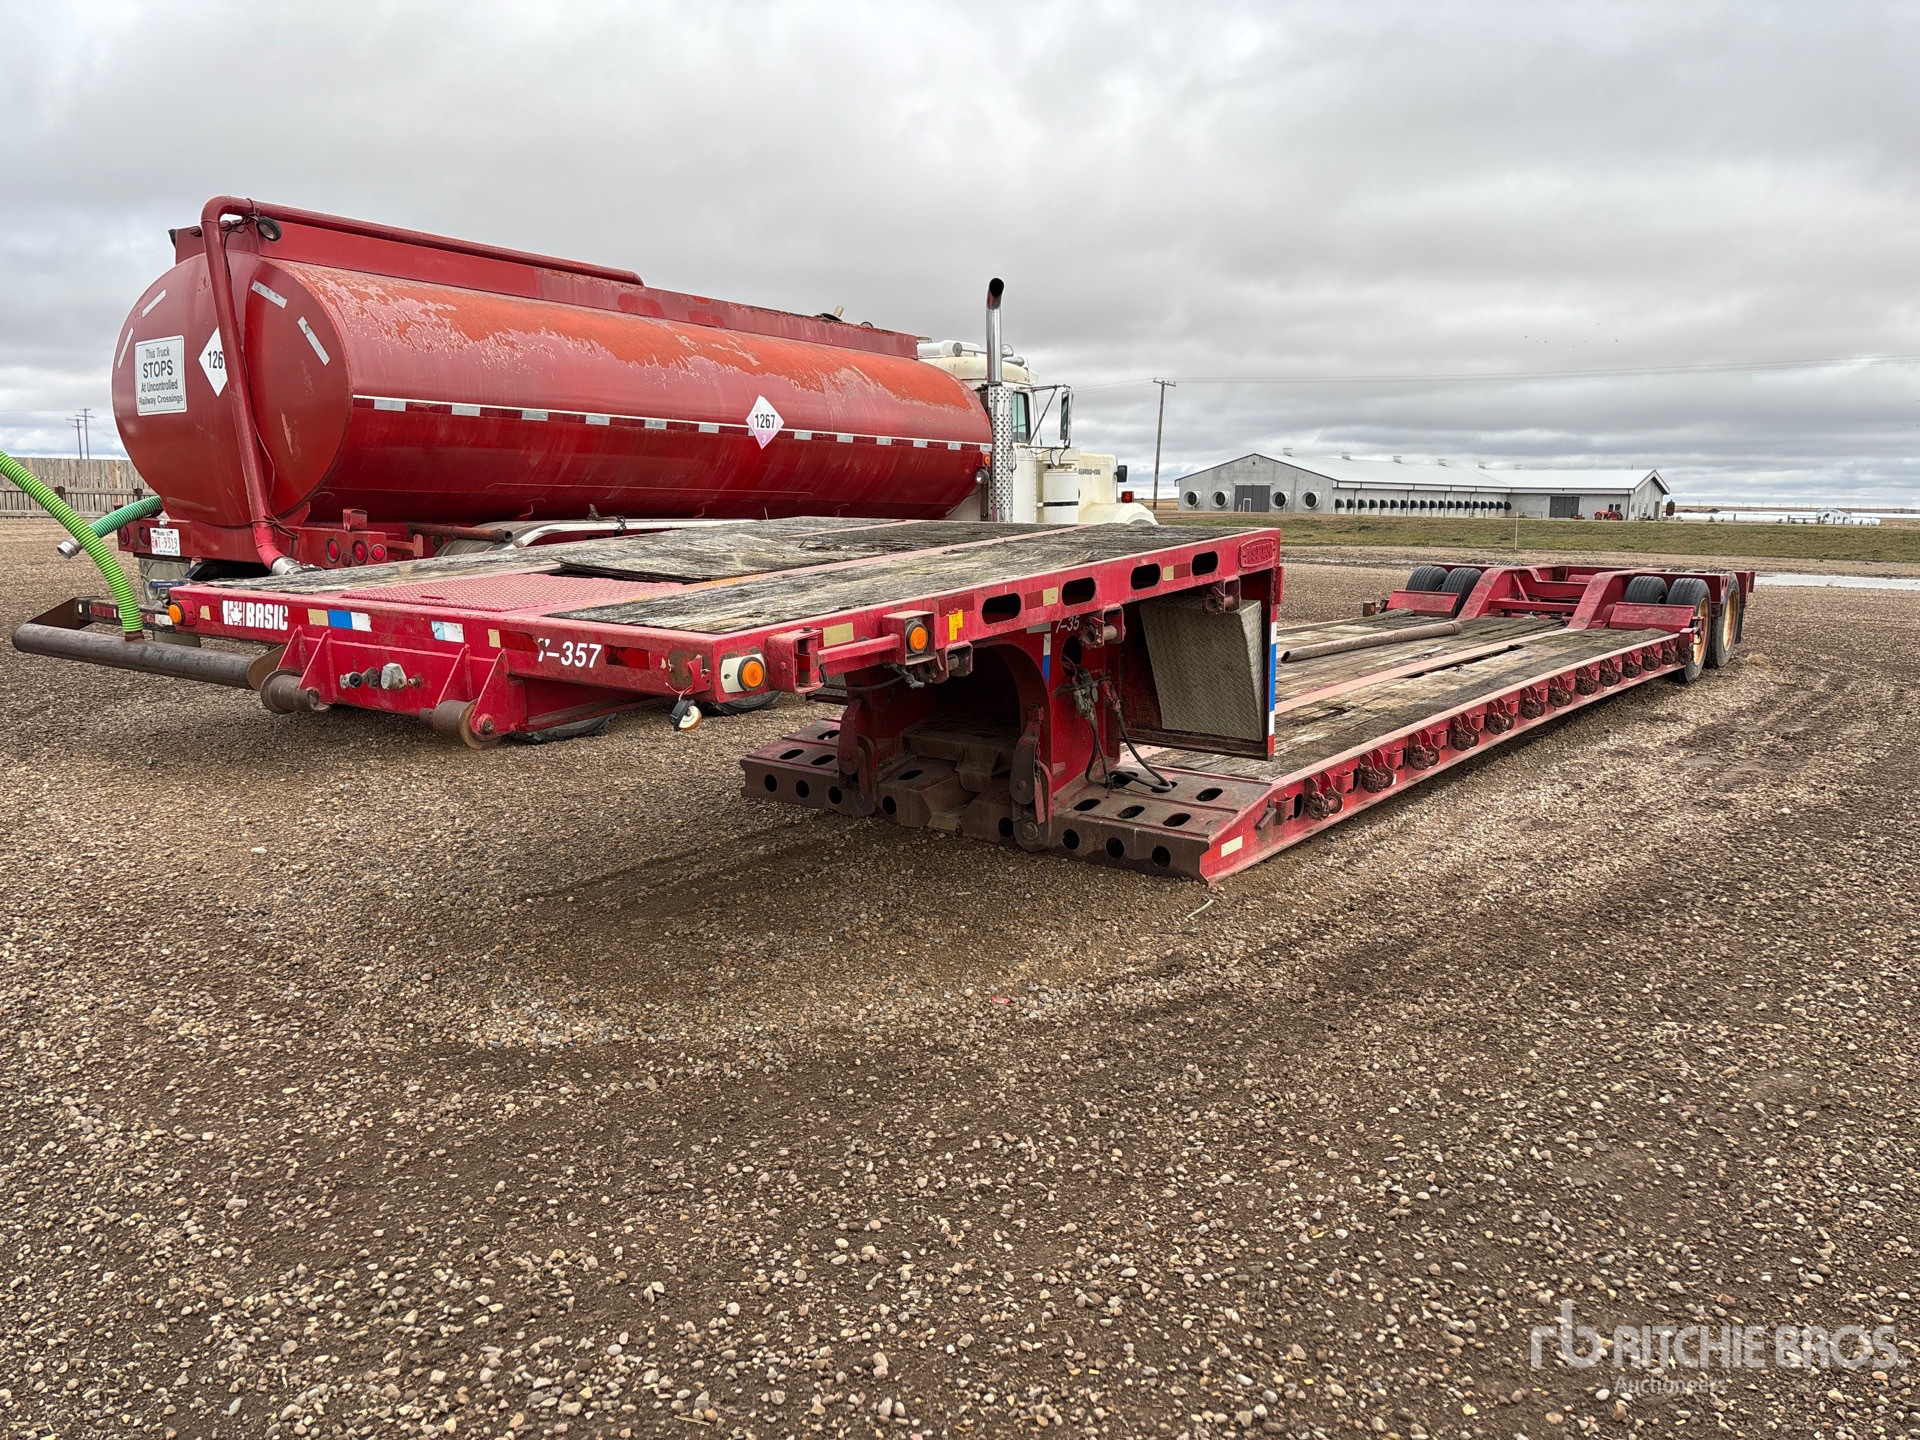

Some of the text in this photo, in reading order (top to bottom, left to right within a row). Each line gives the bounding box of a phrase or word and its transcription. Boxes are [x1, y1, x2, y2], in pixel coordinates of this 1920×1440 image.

[146, 346, 170, 359] This Truck
[207, 350, 223, 369] 126
[143, 359, 173, 379] STOPS
[141, 379, 179, 393] At Uncontrolled
[139, 394, 184, 406] Railway Crossings
[755, 413, 776, 429] 1267
[761, 434, 767, 443] 3
[246, 602, 288, 630] BASIC
